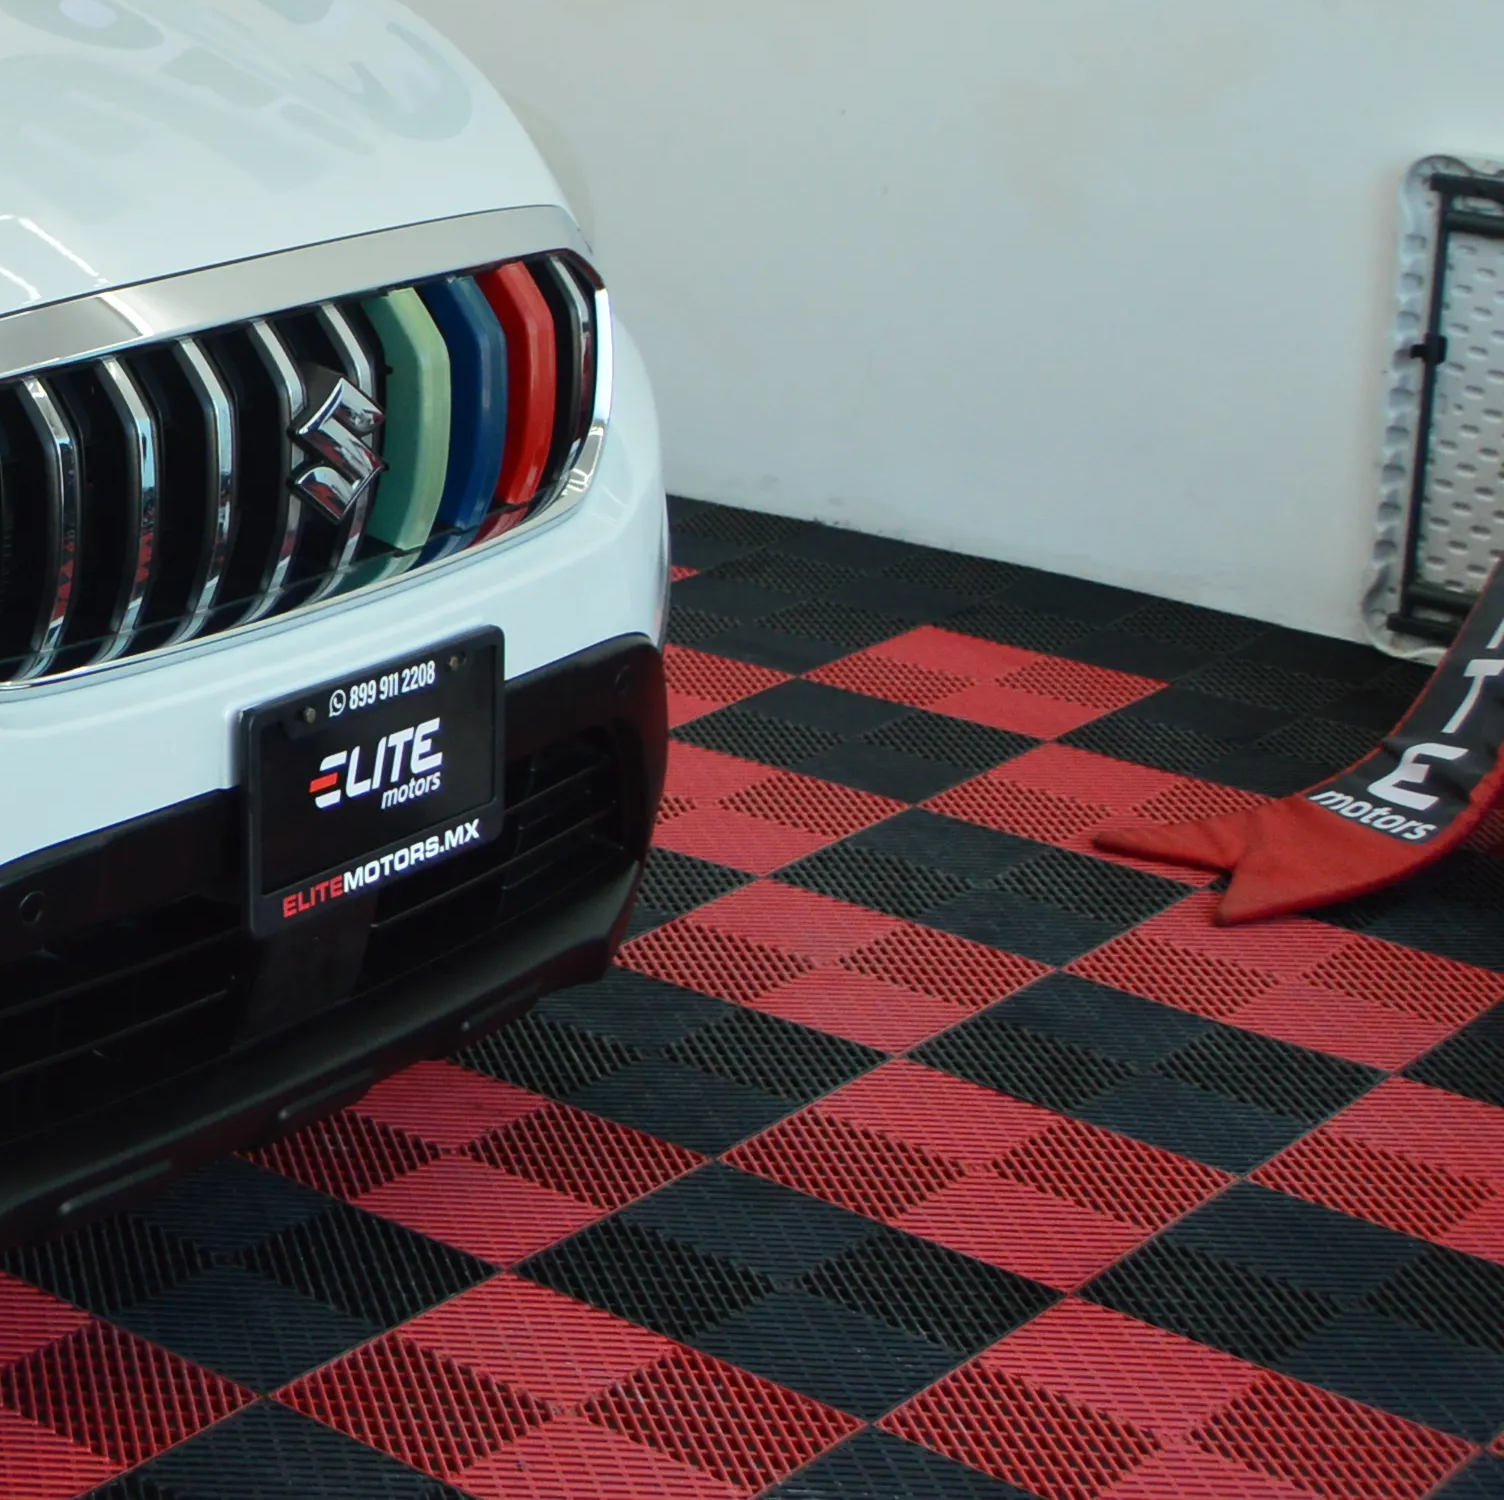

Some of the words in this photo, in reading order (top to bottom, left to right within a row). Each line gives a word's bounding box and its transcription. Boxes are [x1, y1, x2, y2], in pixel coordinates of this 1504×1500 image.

[348, 679, 377, 710] 899
[379, 670, 399, 701] 911
[401, 660, 435, 694] 2208
[309, 717, 443, 809] ELITE
[381, 772, 441, 810] motors
[1308, 790, 1438, 841] motors
[283, 818, 480, 918] ELITEMOTORS.MX
